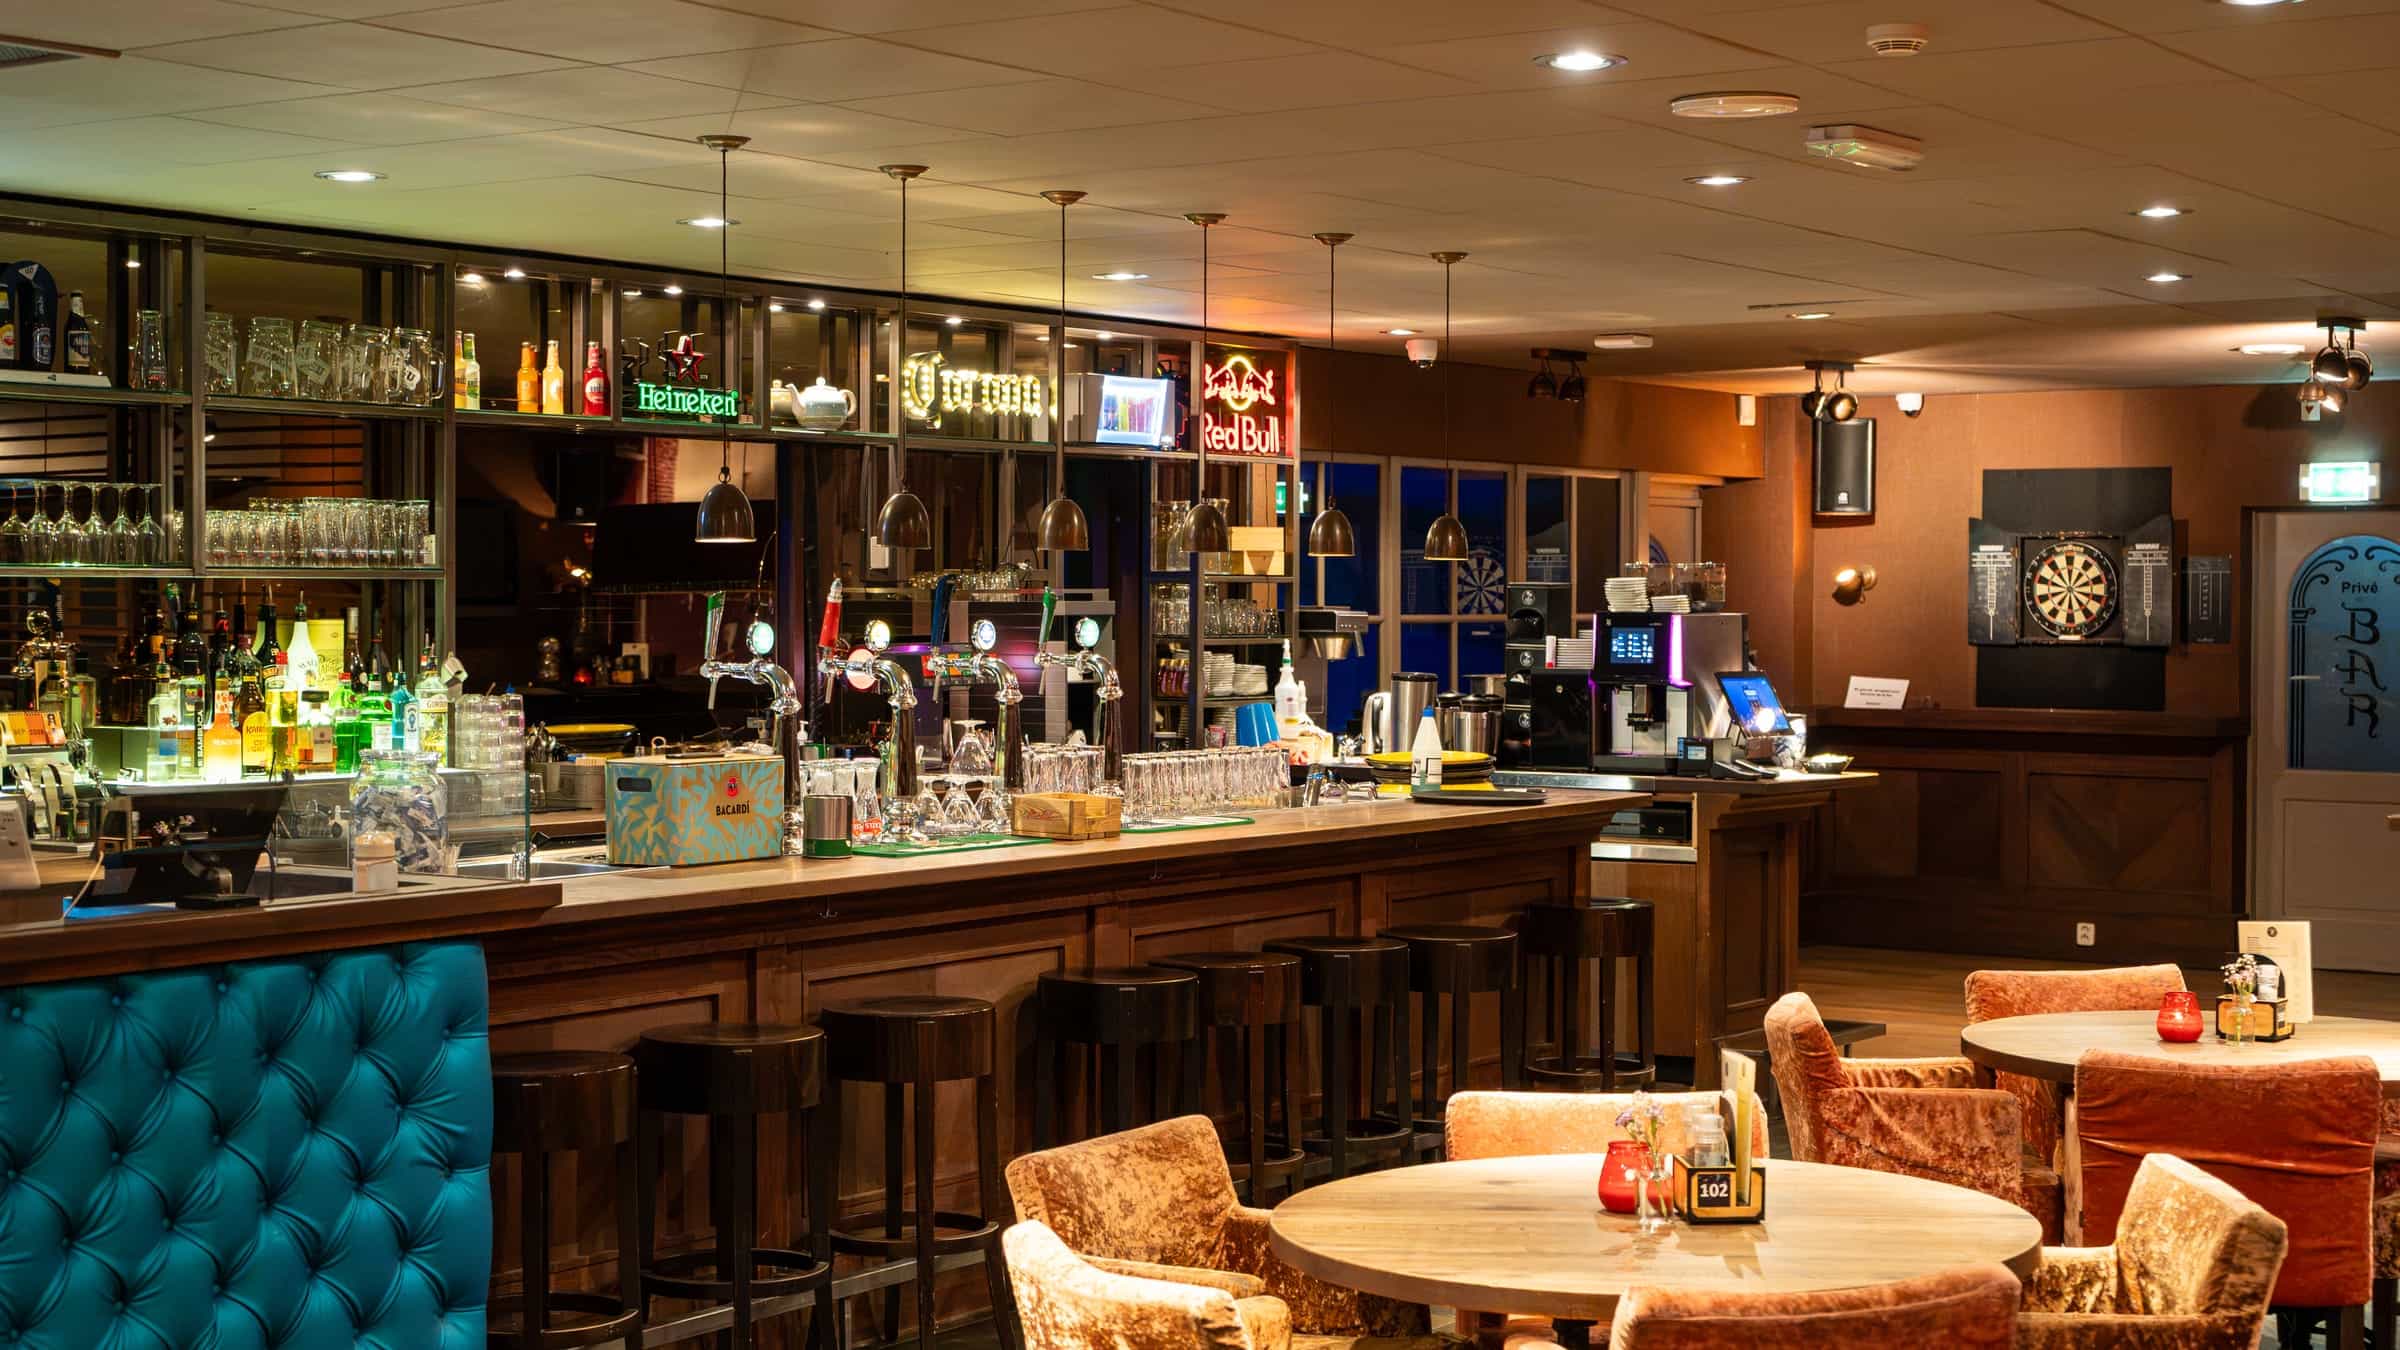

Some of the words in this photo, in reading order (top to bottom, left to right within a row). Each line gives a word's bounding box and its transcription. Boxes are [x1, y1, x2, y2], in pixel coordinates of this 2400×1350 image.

[638, 383, 738, 416] Heineken
[1205, 412, 1239, 450] Red
[1240, 415, 1280, 453] Bull
[2341, 581, 2378, 594] Privé
[2333, 601, 2387, 738] BAR
[1700, 1183, 1729, 1197] 102
